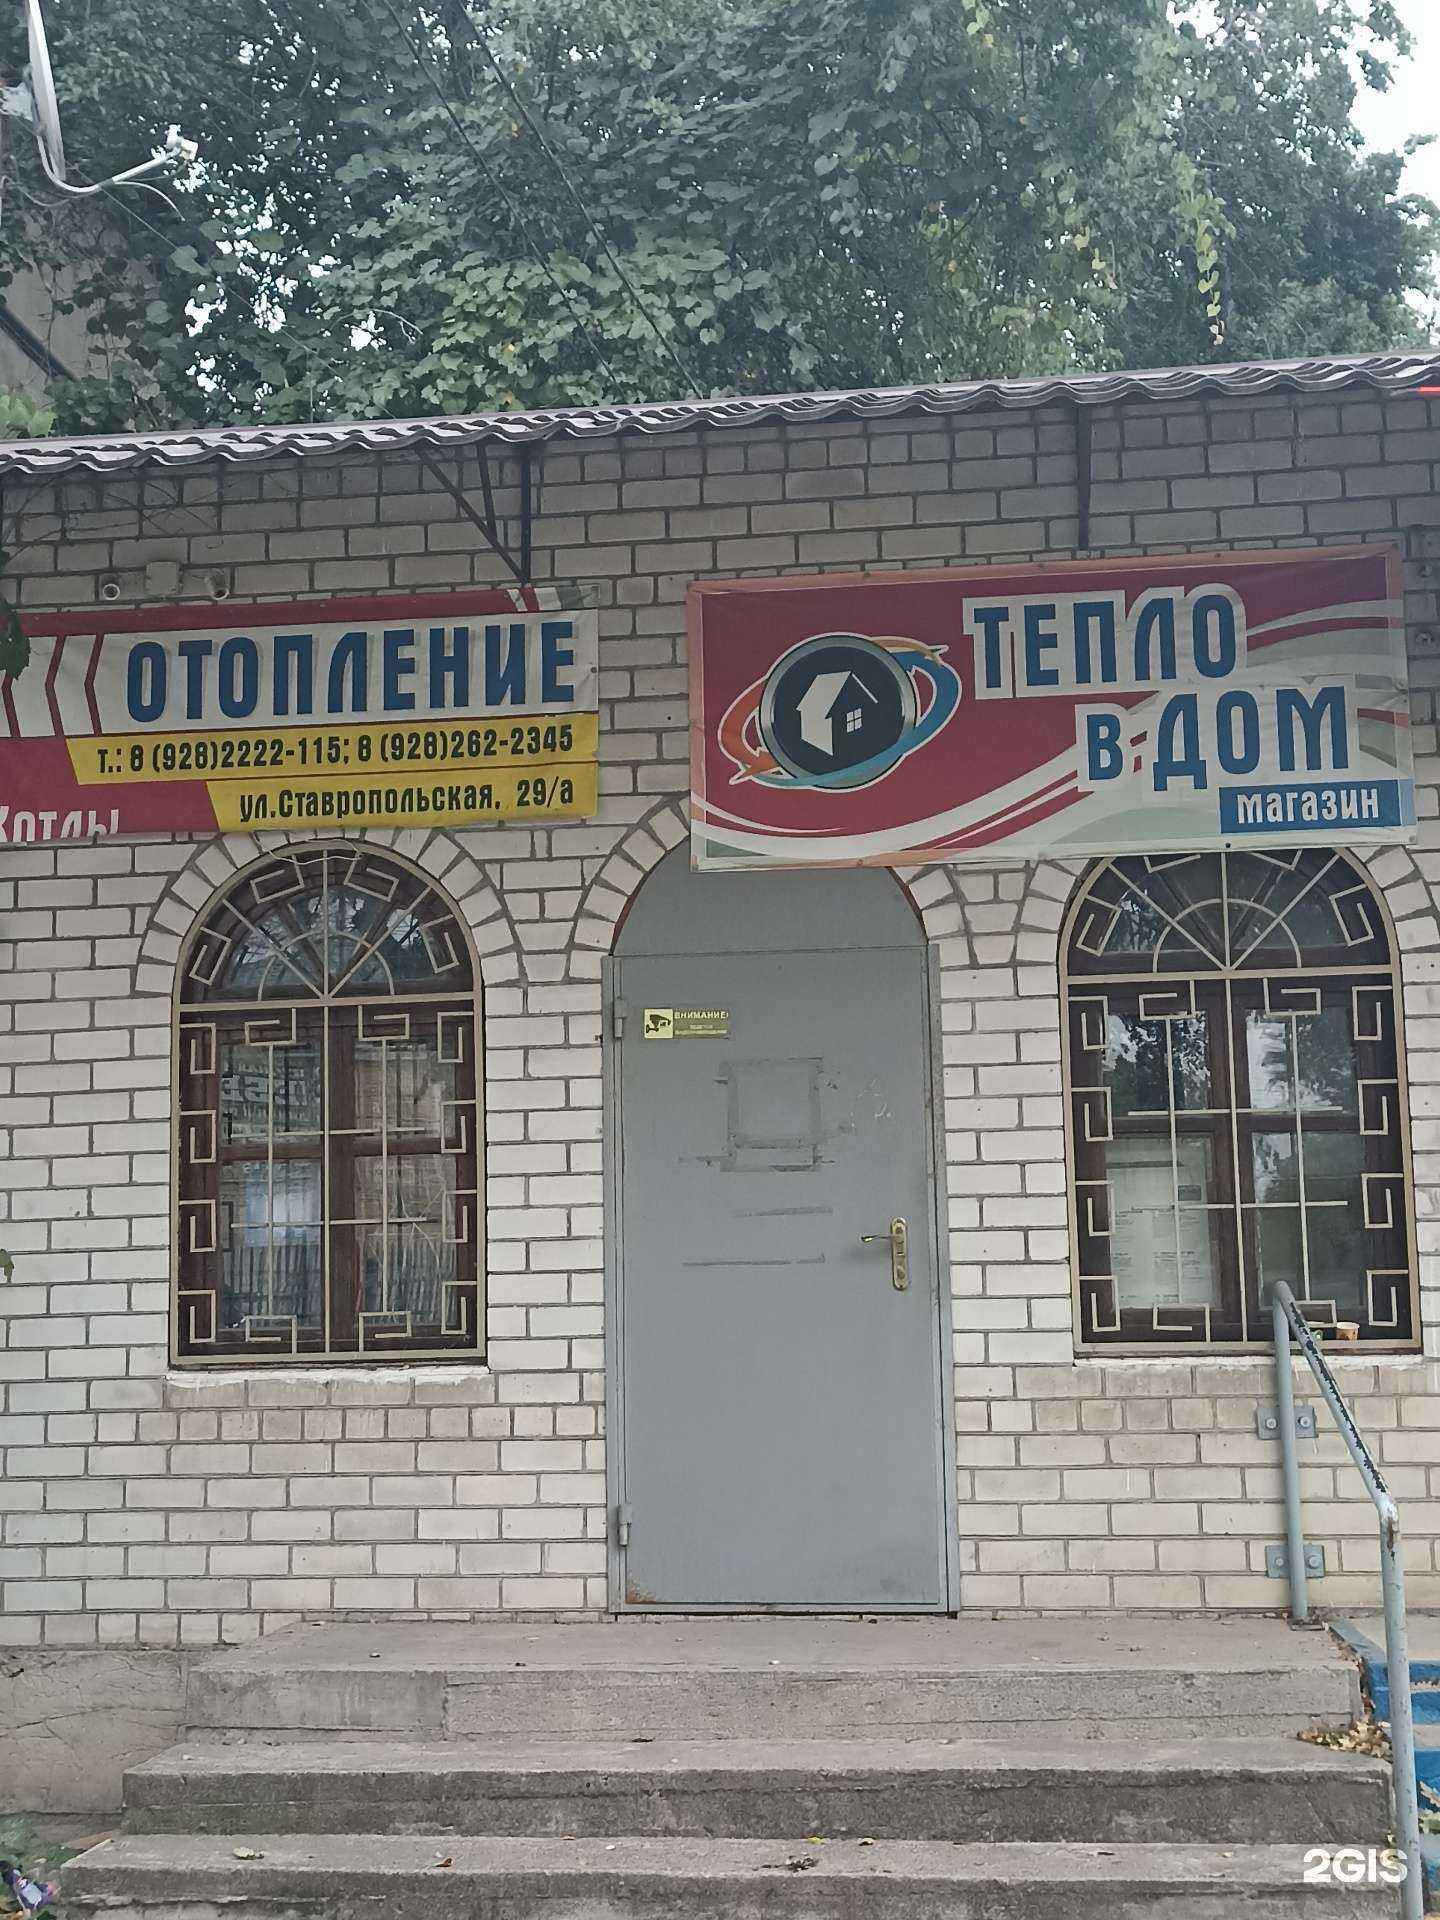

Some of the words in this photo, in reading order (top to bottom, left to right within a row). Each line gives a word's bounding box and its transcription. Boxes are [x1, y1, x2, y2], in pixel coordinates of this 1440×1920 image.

[126, 621, 575, 723] ОТОПЛЕНИЕ
[973, 594, 1236, 689] ТЕПЛО
[130, 744, 144, 772] 8
[357, 735, 372, 762] 8
[380, 724, 573, 763] (928)262-2345
[1086, 713, 1123, 781] В
[1153, 685, 1349, 792] ДОМ
[517, 776, 574, 809] 29/а
[1237, 787, 1379, 824] магазин
